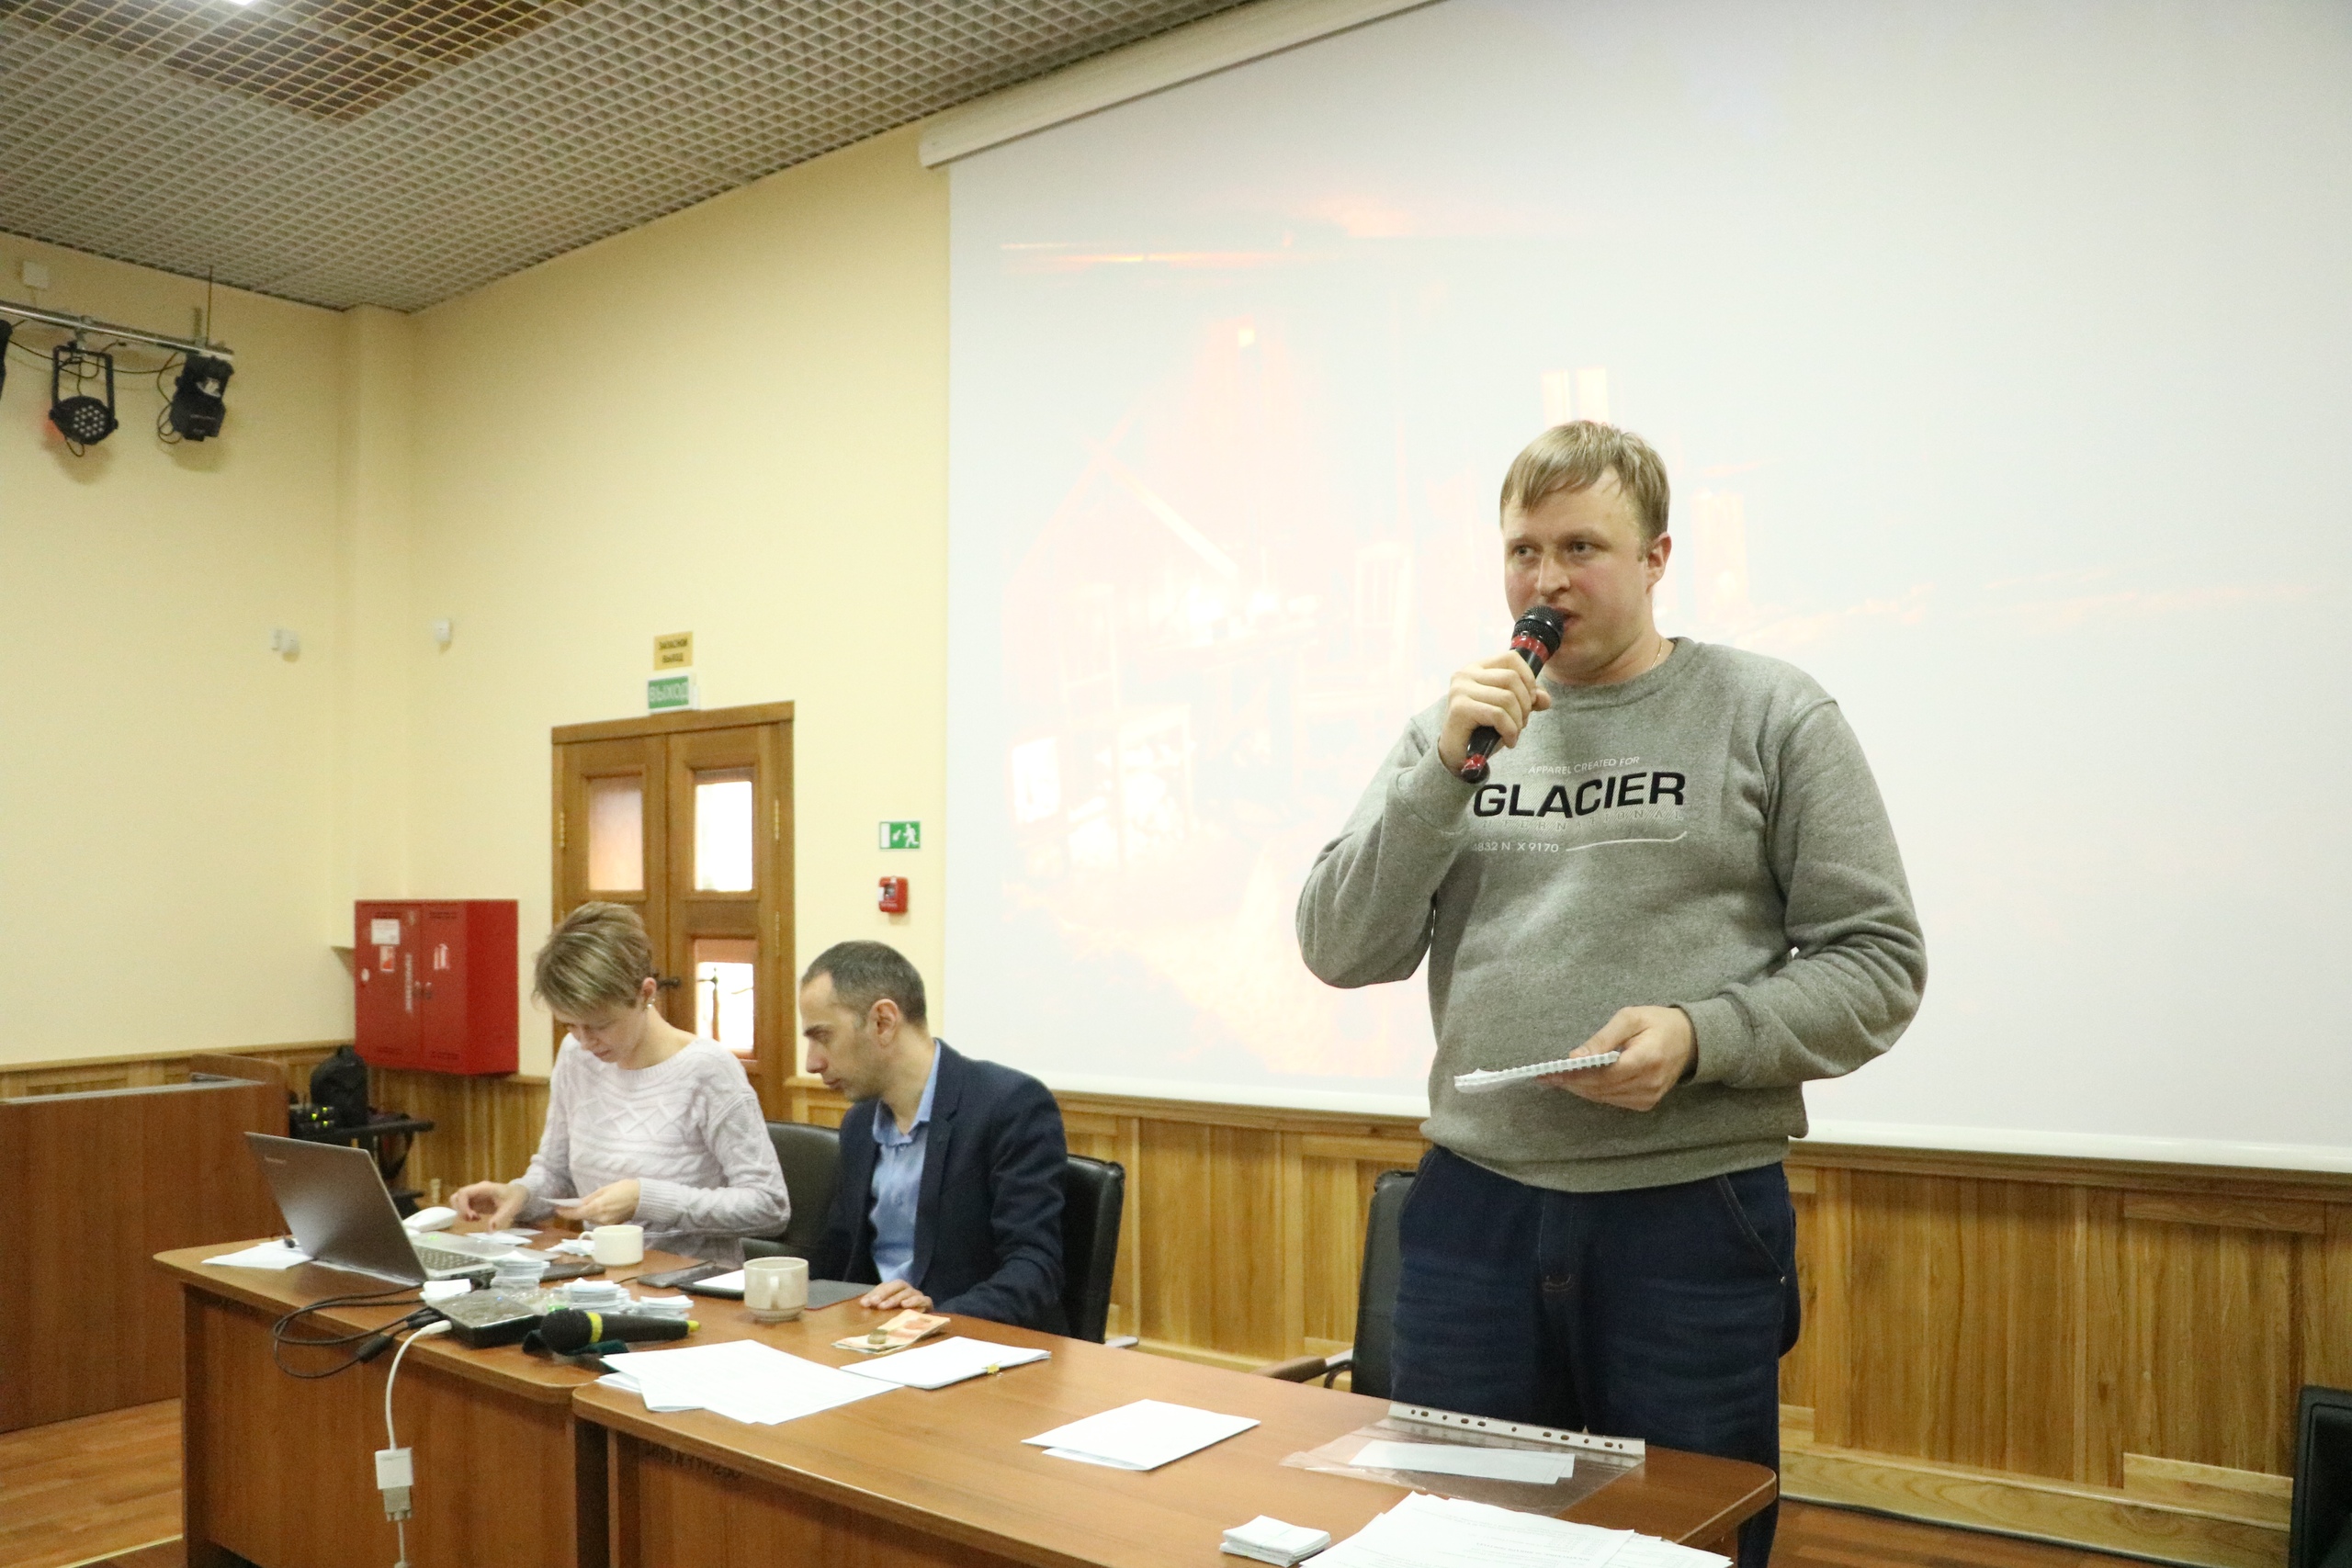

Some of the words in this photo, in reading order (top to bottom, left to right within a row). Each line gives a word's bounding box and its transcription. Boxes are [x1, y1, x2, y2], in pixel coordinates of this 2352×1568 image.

[1528, 765, 1572, 774] APPAREL
[1574, 759, 1616, 773] CREATED
[1619, 756, 1640, 766] FOR
[1473, 772, 1686, 818] GLACIER
[1501, 842, 1511, 852] N
[1516, 843, 1527, 852] X
[1529, 843, 1559, 852] 9170
